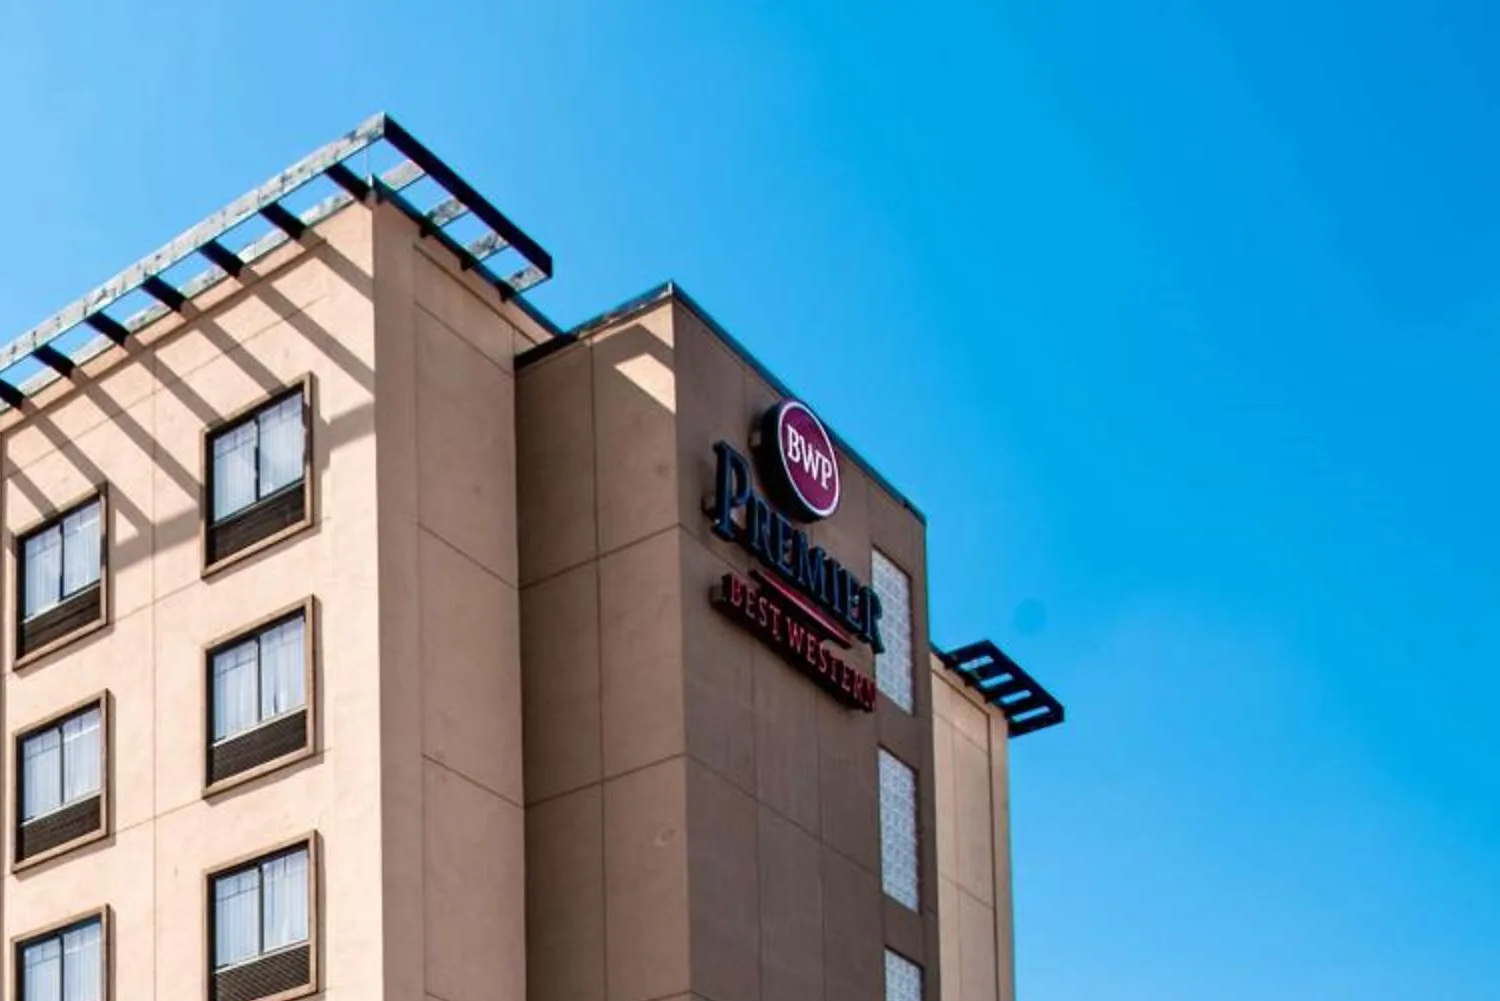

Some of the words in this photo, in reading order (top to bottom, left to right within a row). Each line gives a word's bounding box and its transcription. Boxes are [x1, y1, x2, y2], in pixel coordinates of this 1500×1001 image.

[786, 424, 833, 490] BWP
[712, 440, 885, 654] PREMIER
[725, 572, 782, 642] BEST
[786, 616, 877, 713] WESTERN
